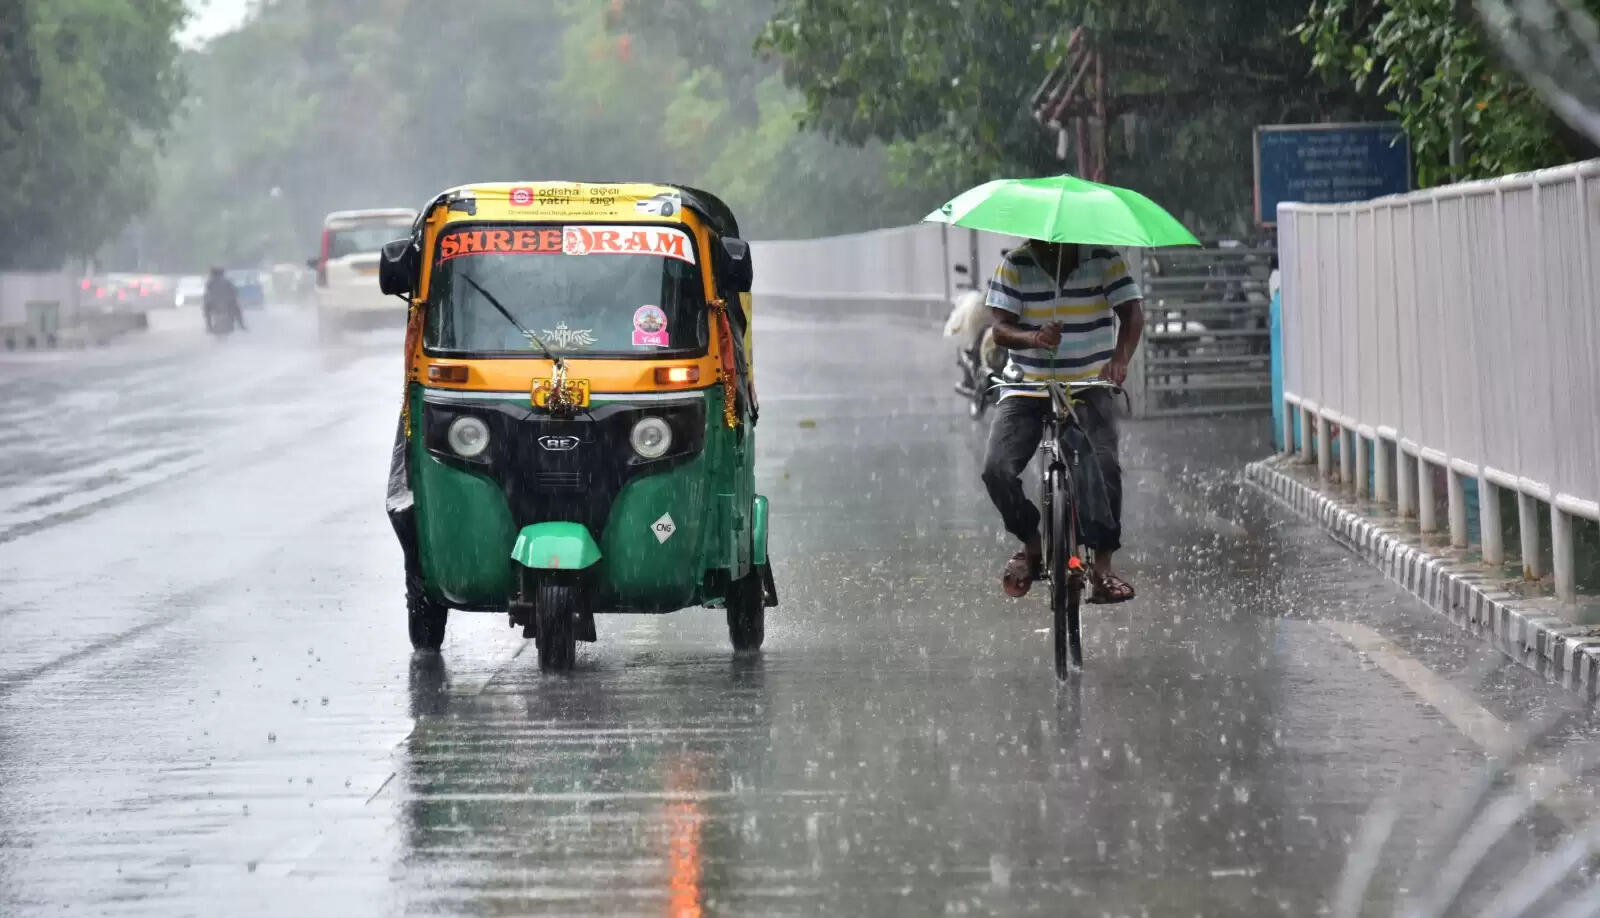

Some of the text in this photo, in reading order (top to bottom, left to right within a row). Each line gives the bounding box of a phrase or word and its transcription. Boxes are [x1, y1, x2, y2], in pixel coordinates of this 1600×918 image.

[539, 187, 579, 196] odisha
[539, 195, 570, 206] yatri
[440, 229, 686, 257] SHREE RAM
[547, 439, 571, 448] RE
[656, 523, 672, 533] CNG
